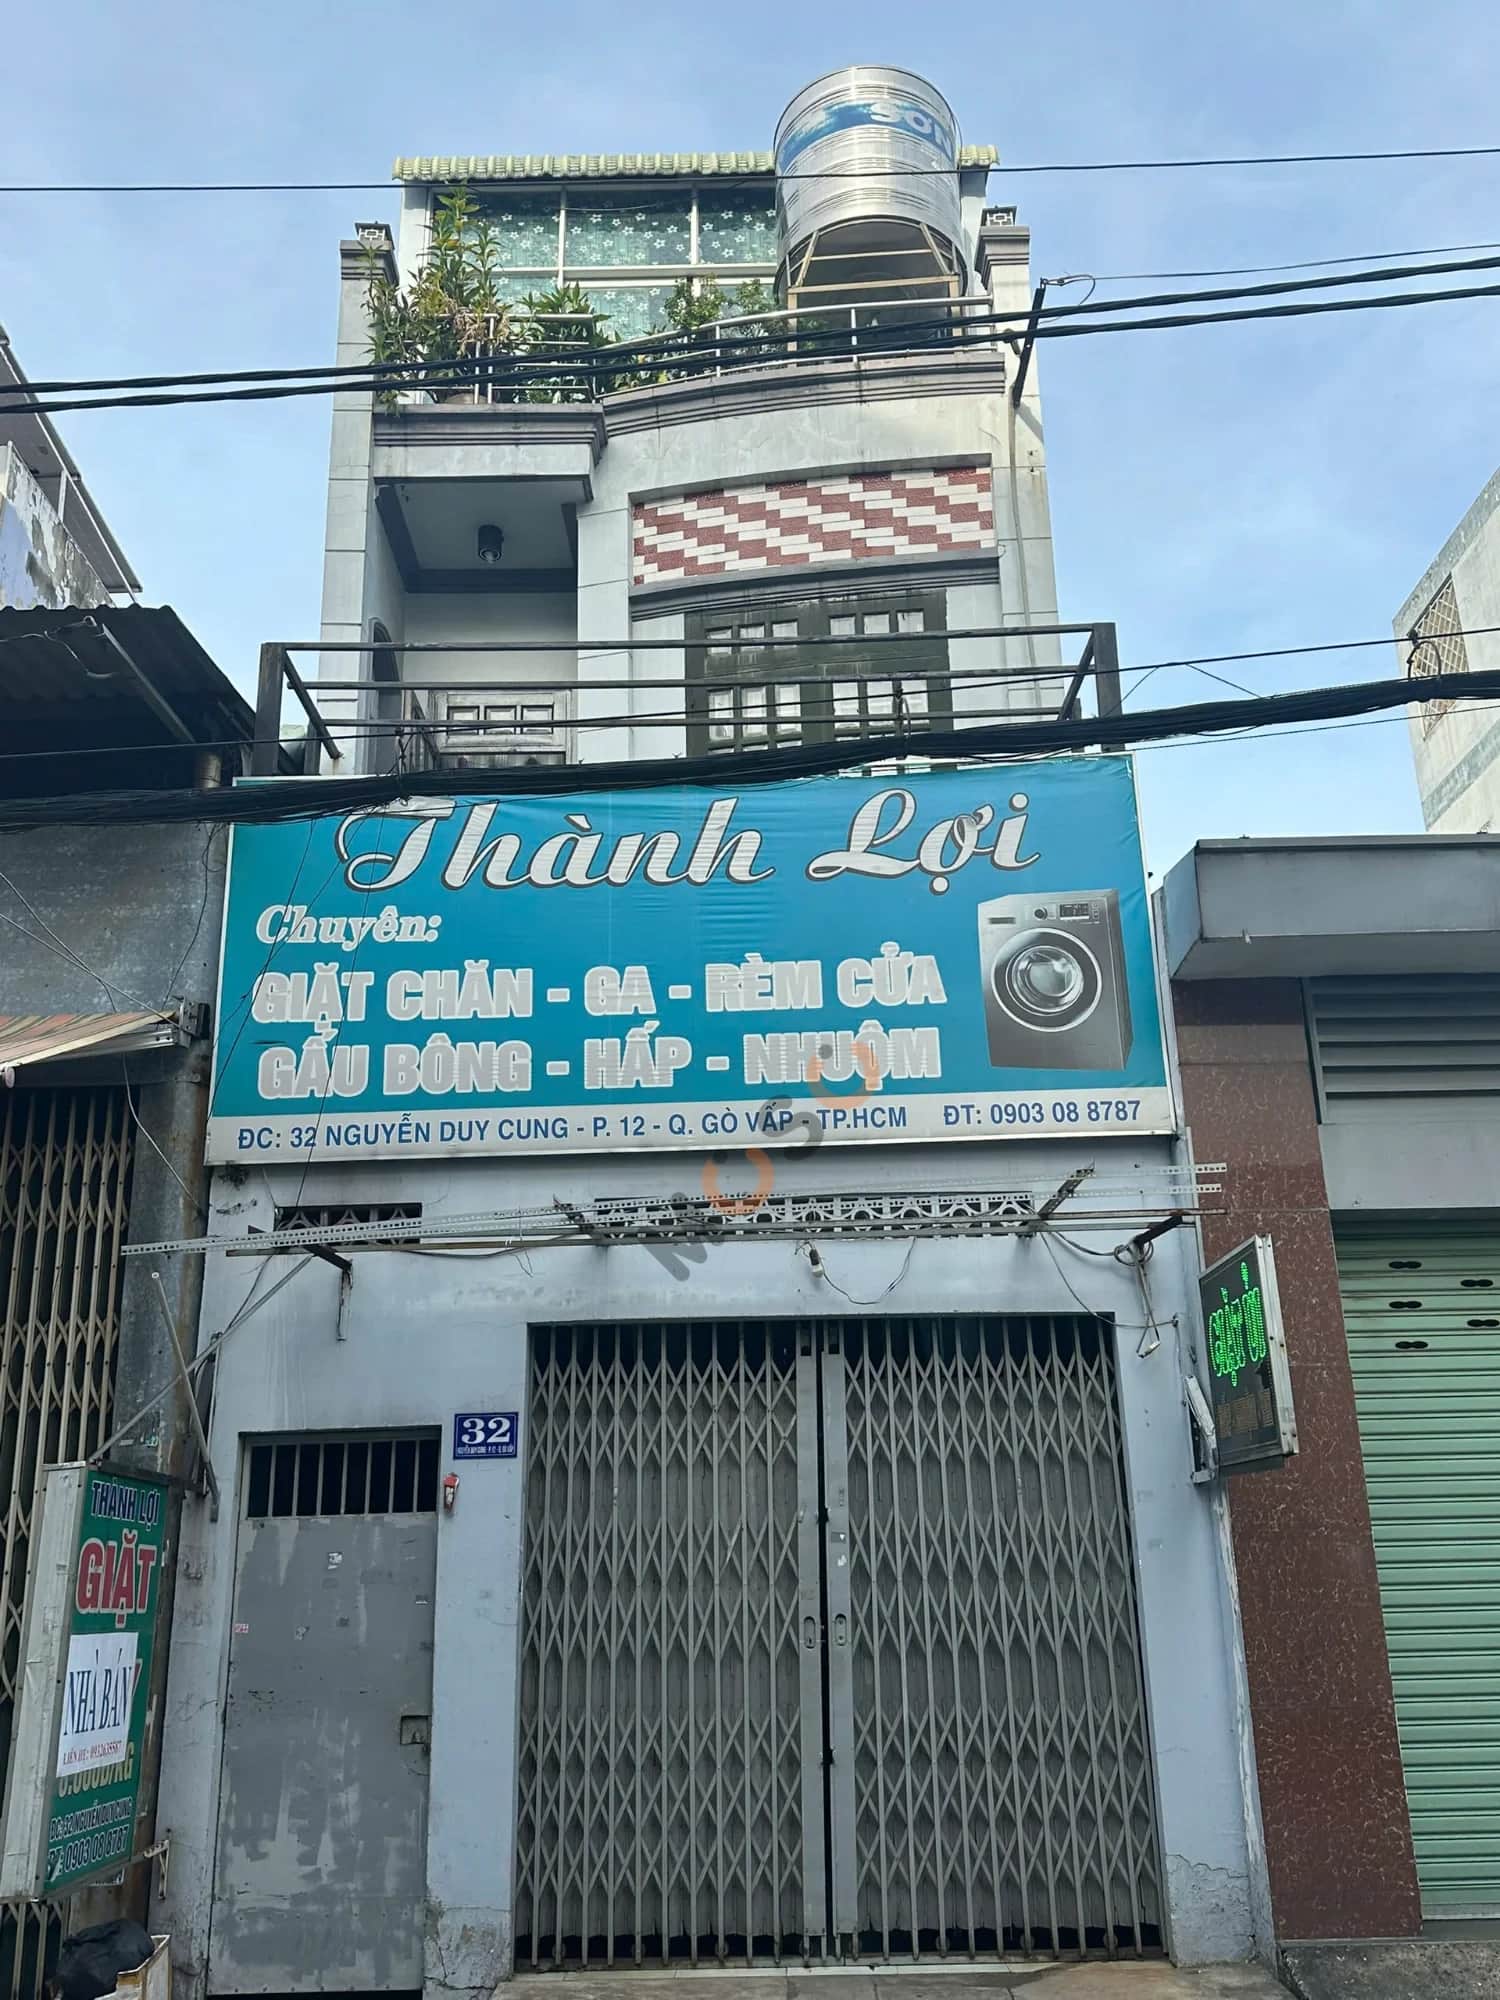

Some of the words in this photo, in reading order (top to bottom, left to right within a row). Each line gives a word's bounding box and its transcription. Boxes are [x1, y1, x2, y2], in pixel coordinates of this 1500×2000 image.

[334, 796, 776, 892] Thành
[805, 788, 1041, 895] Lợi
[255, 904, 442, 951] Chuyên:
[251, 961, 375, 1033] GIẶT
[386, 959, 533, 1021] CHĂN
[546, 988, 570, 1003] -
[584, 965, 656, 1016] GA
[668, 984, 692, 999] -
[705, 952, 822, 1012] RÈM
[836, 941, 947, 1008] CỬA
[257, 1027, 369, 1099] GẤU
[383, 1032, 532, 1095] BÔNG
[546, 1061, 570, 1075] -
[584, 1020, 692, 1089] HẤP
[706, 1056, 730, 1071] -
[744, 1019, 941, 1091] NHUỘM
[238, 1126, 282, 1150] ĐC:
[289, 1126, 317, 1148] 32
[326, 1113, 431, 1147] NGUYỄN
[439, 1119, 490, 1143] DUY
[498, 1117, 569, 1141] CUNG
[593, 1118, 612, 1137] P.
[620, 1116, 645, 1137] 12
[669, 1114, 693, 1136] Q.
[702, 1107, 738, 1134] GÒ
[745, 1100, 794, 1133] VẤP
[816, 1107, 908, 1131] TP.HCM
[944, 1103, 984, 1126] ĐT:
[990, 1102, 1044, 1125] 0903
[1052, 1101, 1079, 1123] 08
[1087, 1099, 1141, 1122] 8787
[461, 1417, 510, 1445] 32
[75, 1527, 157, 1629] GIẶT
[63, 1647, 99, 1735] NHÀ
[98, 1647, 132, 1730] BÁN
[64, 1836, 92, 1873] 0903
